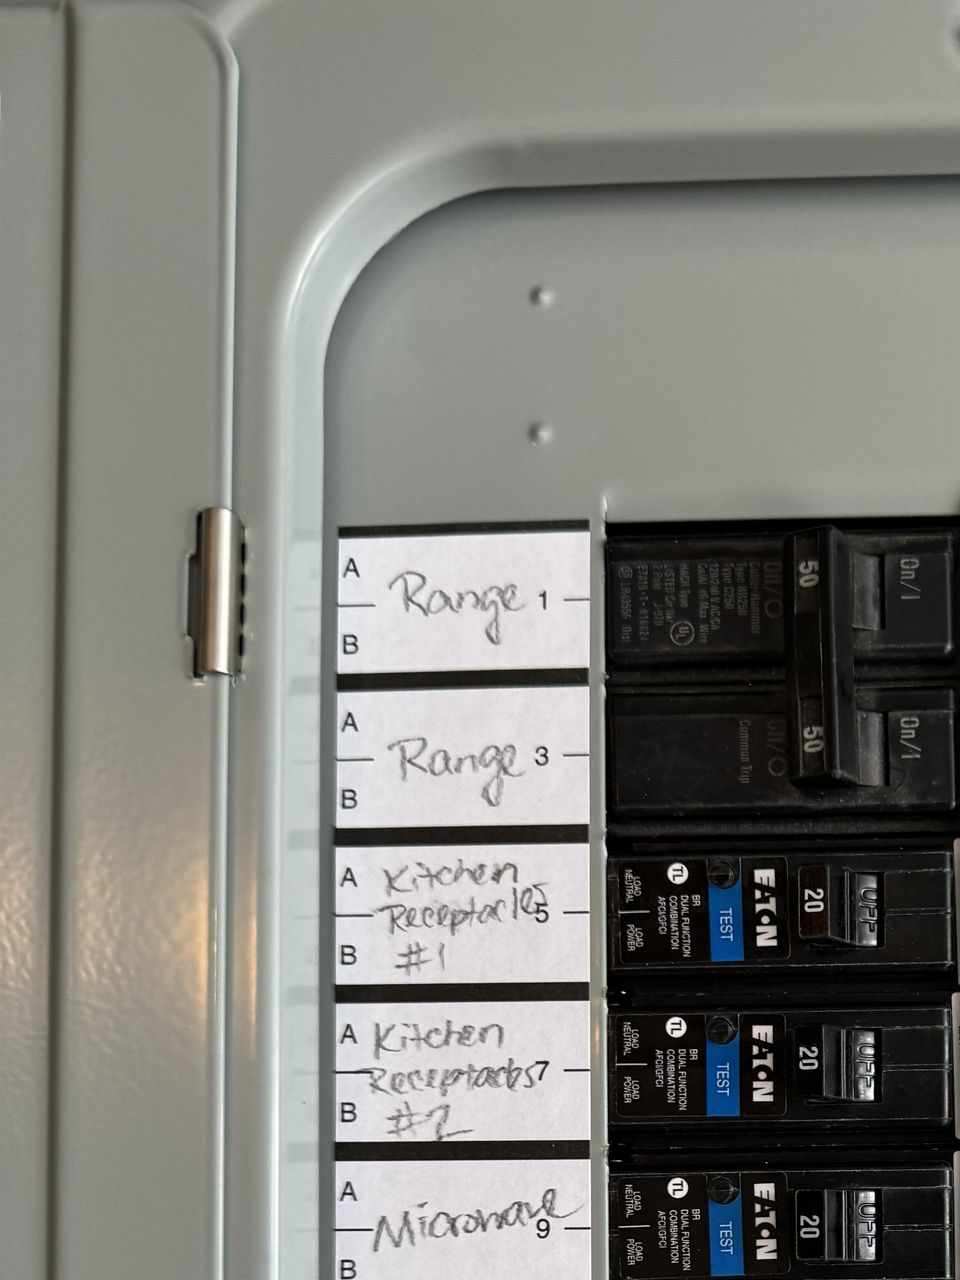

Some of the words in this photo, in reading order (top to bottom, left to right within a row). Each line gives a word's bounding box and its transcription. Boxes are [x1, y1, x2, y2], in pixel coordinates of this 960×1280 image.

[342, 557, 360, 578] A
[799, 560, 820, 588] 50
[389, 570, 526, 645] Range
[538, 590, 547, 610] 1
[342, 634, 359, 655] B
[341, 711, 359, 733] A
[803, 726, 825, 753] 50
[534, 745, 549, 767] 3
[388, 737, 526, 806] Range
[737, 765, 752, 785] Trip
[341, 788, 358, 810] B
[340, 866, 358, 888] A
[383, 859, 518, 897] Kitchen
[625, 869, 633, 903] NEUTRAL
[692, 895, 700, 907] BR
[754, 869, 777, 946] EATON
[804, 888, 824, 912] 20
[535, 904, 548, 923] 5
[669, 896, 679, 950] COMBINATION
[720, 908, 733, 941] TEST
[627, 924, 635, 951] POWER
[635, 928, 643, 947] LOAD
[682, 917, 690, 957] FUNCTION
[340, 944, 357, 966] B
[395, 942, 444, 975] #1
[339, 1023, 358, 1045] A
[374, 1020, 504, 1059] Kitchen
[623, 1022, 631, 1055] NEUTRAL
[678, 1049, 687, 1069] DUAL
[690, 1049, 698, 1060] BR
[752, 1025, 773, 1102] EATON
[799, 1047, 818, 1070] 20
[535, 1061, 550, 1081] 7
[667, 1049, 675, 1103] COMBINATION
[716, 1062, 729, 1096] TEST
[679, 1070, 687, 1110] FUNCTION
[340, 1101, 357, 1123] B
[387, 1101, 474, 1141] #2
[339, 1180, 358, 1202] A
[625, 1185, 633, 1218] NEUTRAL
[633, 1191, 641, 1210] LOAD
[681, 1209, 689, 1229] DUAL
[692, 1209, 700, 1220] BR
[754, 1183, 777, 1260] EATON
[535, 1218, 551, 1240] 9
[669, 1210, 679, 1263] COMBINATION
[720, 1222, 733, 1254] TEST
[800, 1215, 819, 1238] 20
[627, 1239, 635, 1265] POWER
[635, 1242, 643, 1261] LOAD
[681, 1230, 690, 1270] FUNCTION
[340, 1259, 357, 1280] B
